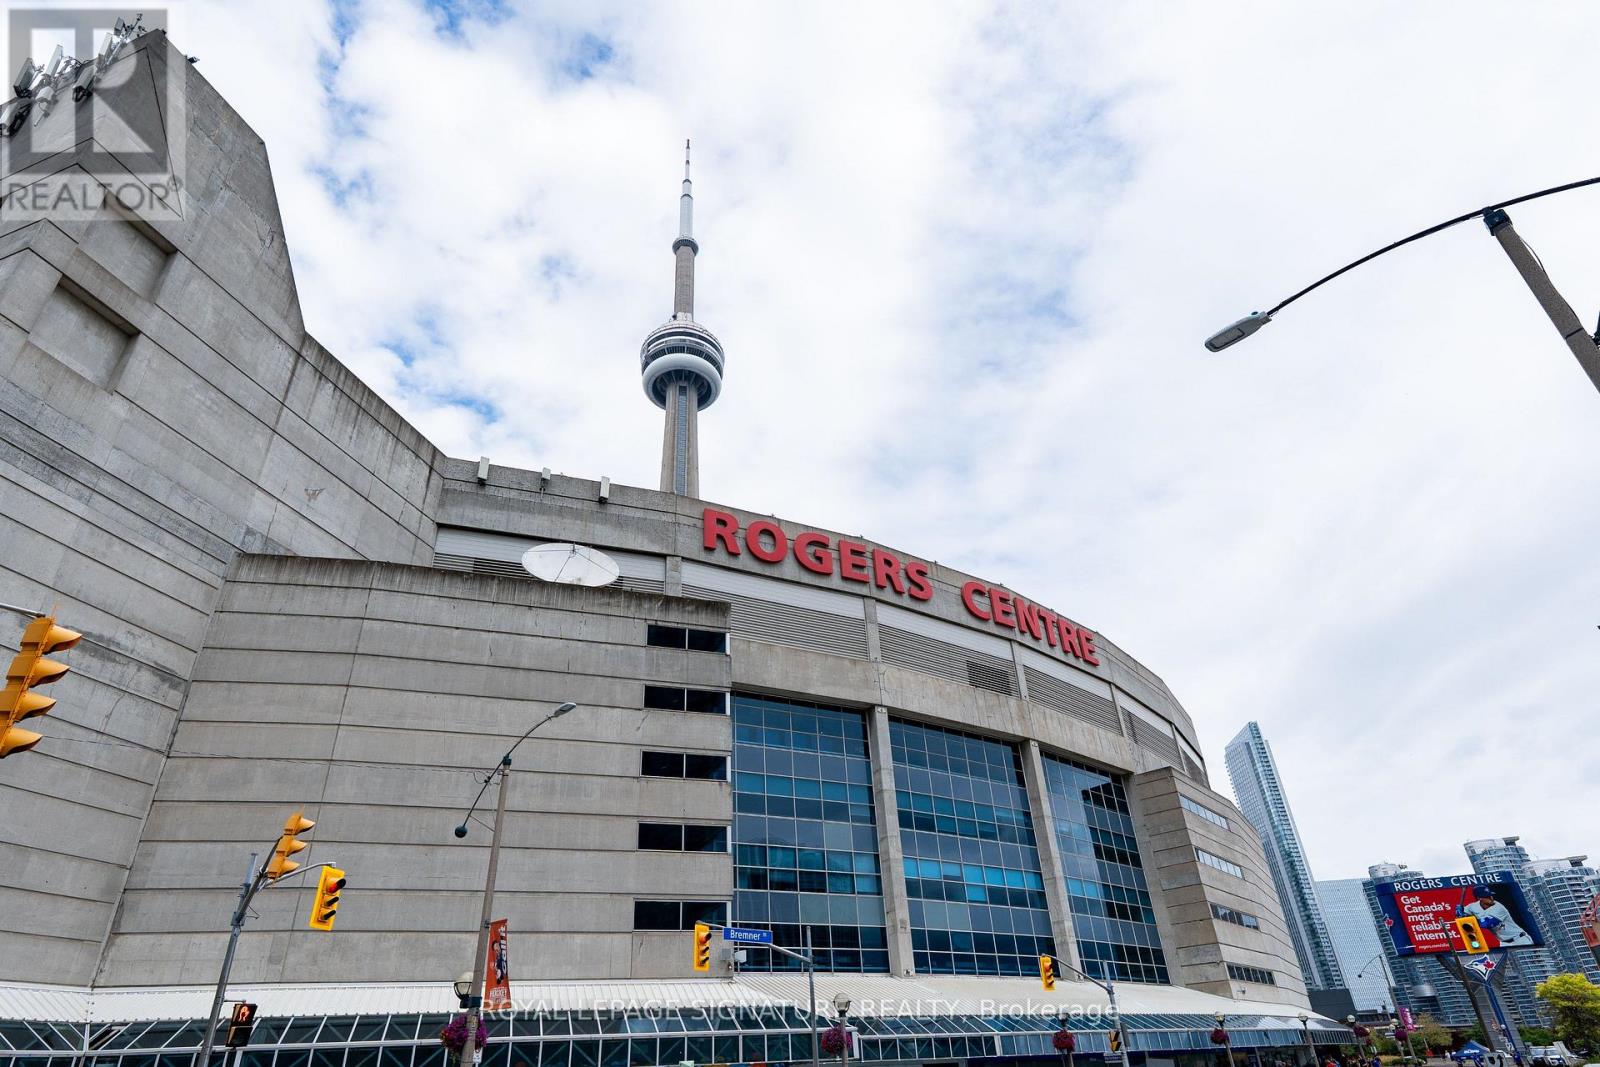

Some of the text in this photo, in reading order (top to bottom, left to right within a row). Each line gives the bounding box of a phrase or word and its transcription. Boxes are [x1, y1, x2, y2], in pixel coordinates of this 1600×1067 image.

[703, 507, 1100, 667] ROGERS CENTRE
[1394, 873, 1502, 892] ROGERS CENTRE
[1400, 895, 1422, 904] Get
[1404, 902, 1451, 913] Canada's
[1407, 913, 1435, 922] most
[1411, 920, 1451, 932] reliabe
[730, 929, 761, 941] Bremner
